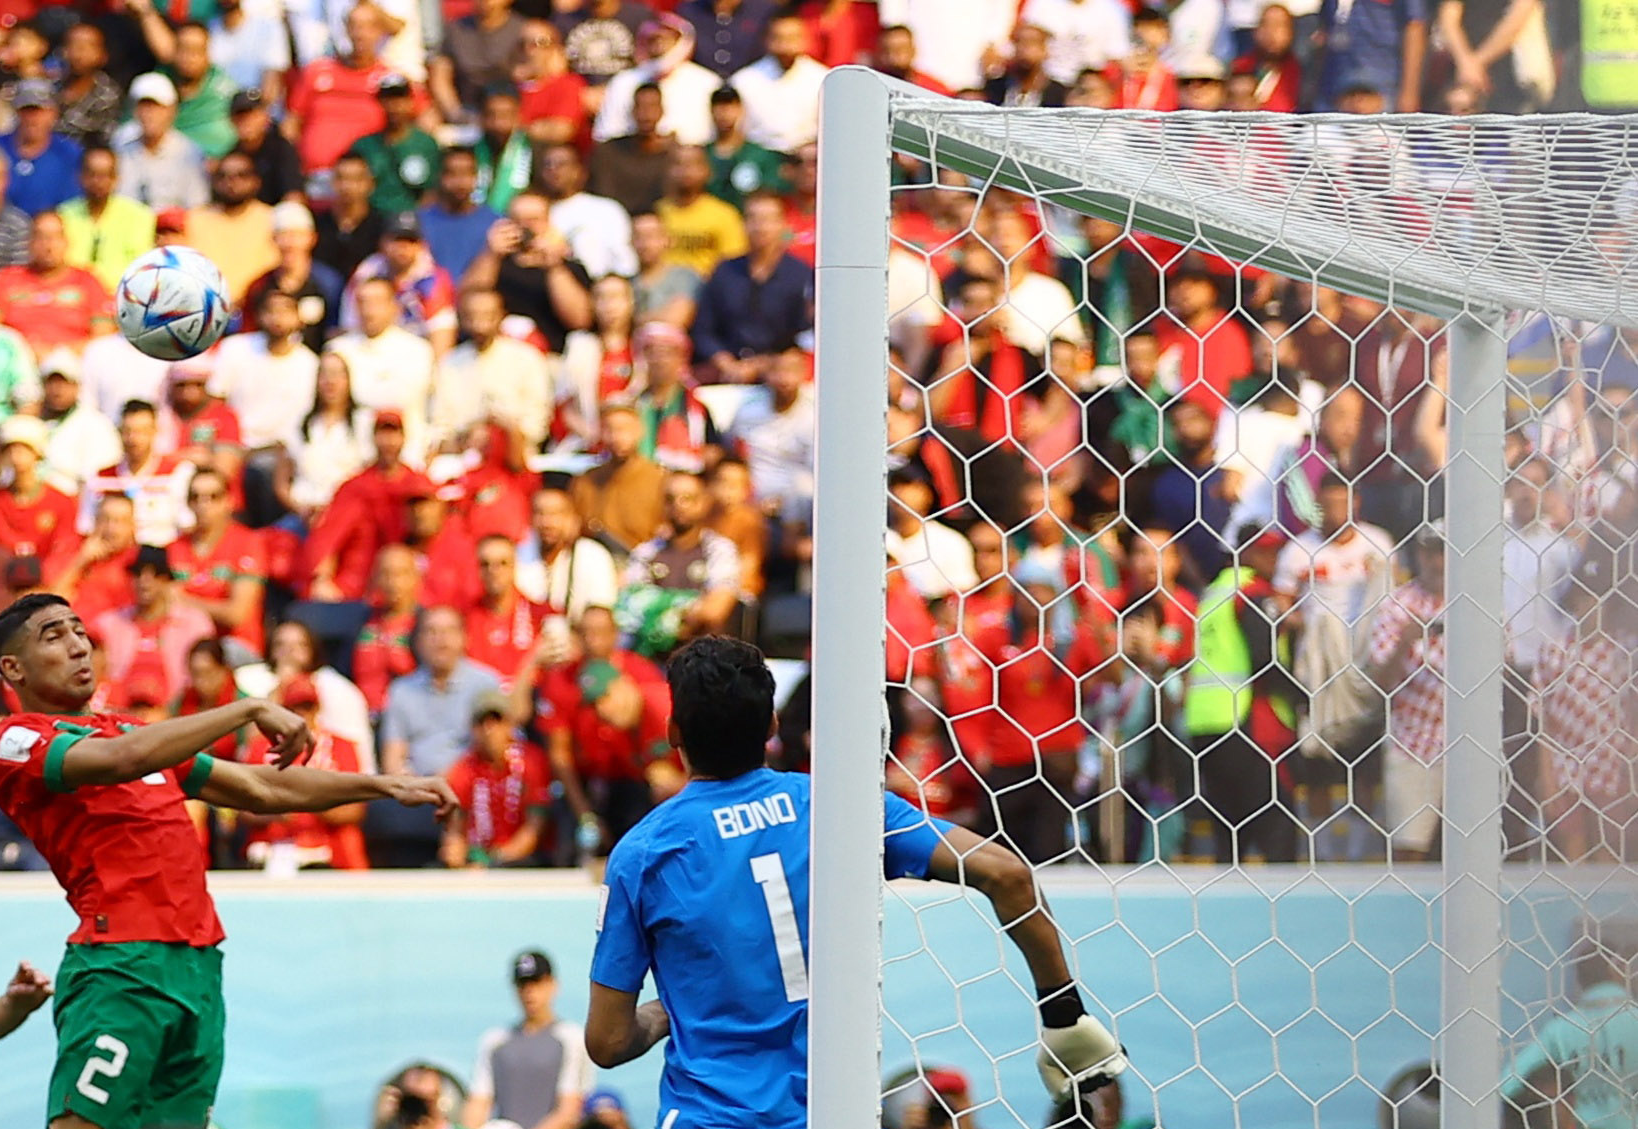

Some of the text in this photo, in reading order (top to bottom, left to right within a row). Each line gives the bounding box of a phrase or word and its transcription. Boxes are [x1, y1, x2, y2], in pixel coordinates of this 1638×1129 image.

[712, 792, 797, 840] BONO
[750, 852, 809, 1003] 1
[76, 1034, 129, 1105] 2
